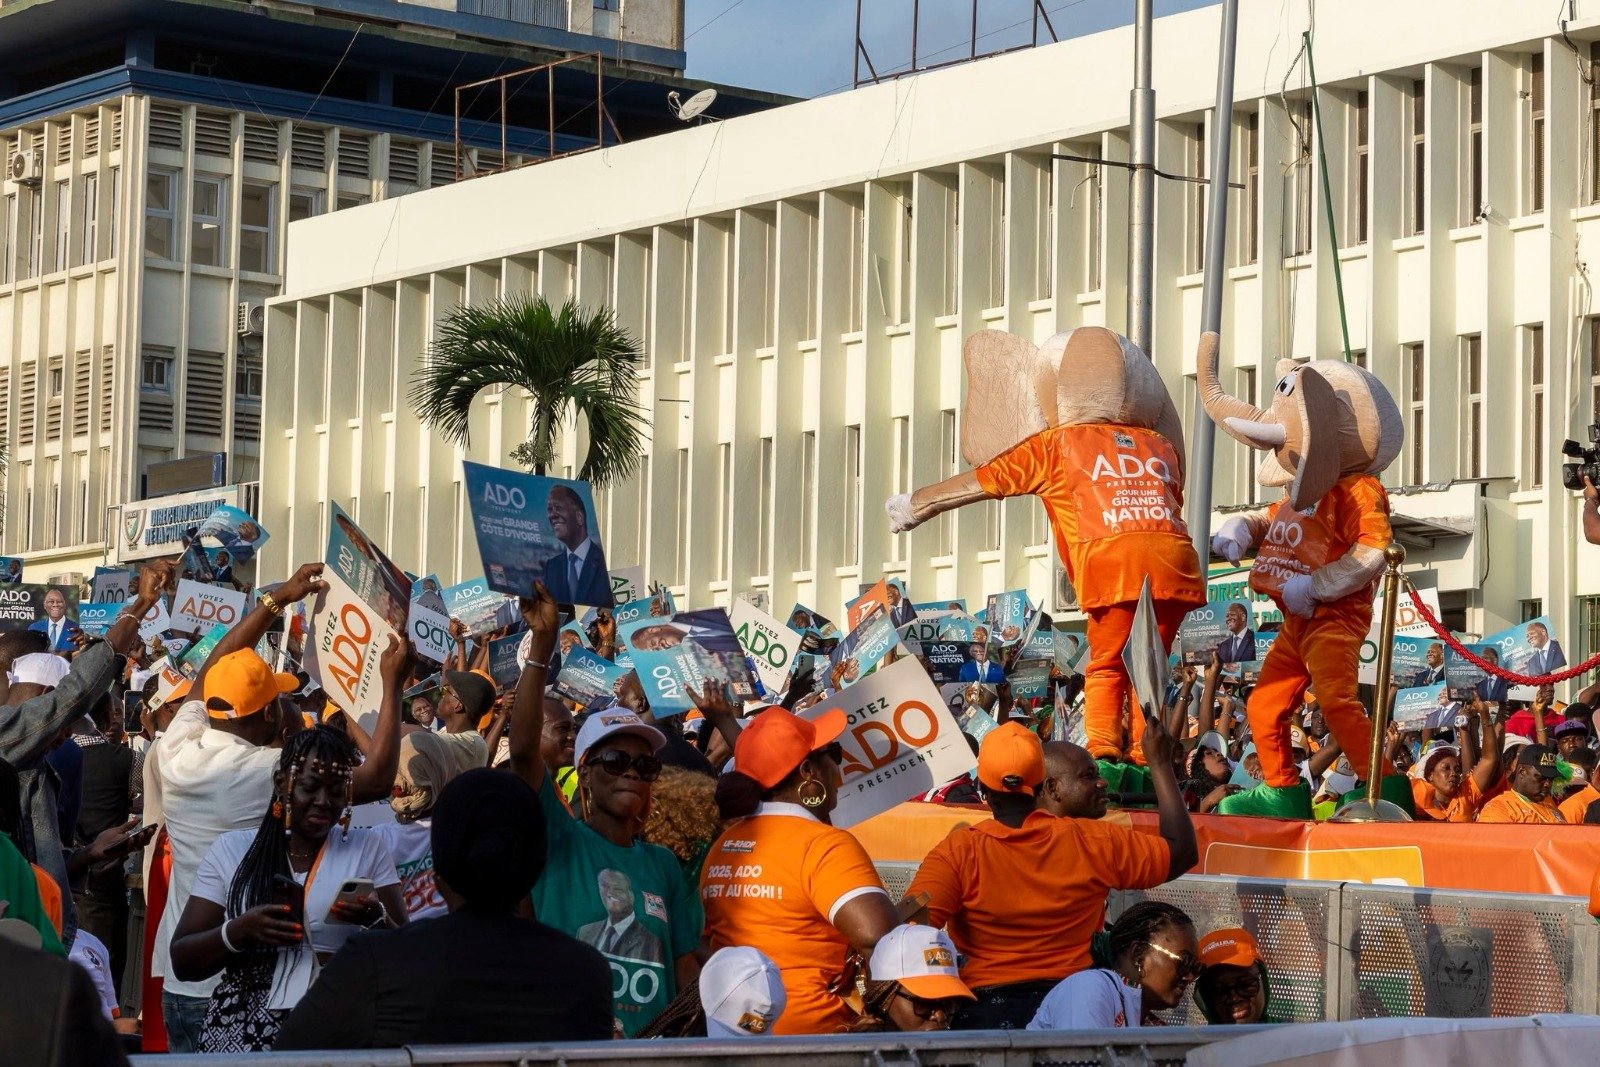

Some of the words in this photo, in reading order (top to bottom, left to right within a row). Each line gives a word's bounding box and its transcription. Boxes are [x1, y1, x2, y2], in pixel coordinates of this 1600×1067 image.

[1092, 454, 1170, 482] ADO
[484, 482, 525, 509] ADO
[1112, 496, 1165, 506] GRANDE
[481, 523, 505, 537] CÔTE
[505, 529, 541, 543] D'IVOIRE
[503, 517, 539, 531] GRANDE
[338, 545, 353, 578] ADO
[0, 590, 30, 602] ADO
[198, 593, 223, 603] VOTEZ
[456, 586, 482, 601] ADO
[611, 576, 630, 604] AD
[79, 609, 106, 617] ADO
[180, 597, 236, 624] ADO
[1013, 597, 1021, 616] ADO
[1189, 610, 1214, 621] ADO
[322, 611, 337, 653] VOTEZ
[414, 620, 455, 652] ADO
[754, 620, 778, 640] VOTEZ
[904, 624, 940, 640] AD
[1397, 624, 1428, 632] RÉSIDENT
[425, 641, 446, 655] VOTEZ
[735, 622, 787, 668] ADO
[869, 637, 888, 659] ADO
[931, 645, 957, 653] ADO
[1032, 637, 1052, 645] ADO
[1394, 642, 1417, 652] ADO
[328, 603, 371, 705] ADO
[1451, 652, 1464, 661] AD
[361, 642, 380, 699] PRÉSIDENT
[578, 655, 605, 673] ADO
[652, 665, 681, 698] ADO
[1405, 691, 1428, 700] ADO
[847, 697, 889, 725] OTEZ
[836, 700, 939, 787] ADO
[857, 750, 933, 792] PRÉSIDENT
[735, 864, 762, 879] ADO
[725, 884, 742, 898] AU
[743, 884, 775, 899] KOHI
[777, 886, 783, 900] !
[610, 961, 659, 1004] DO
